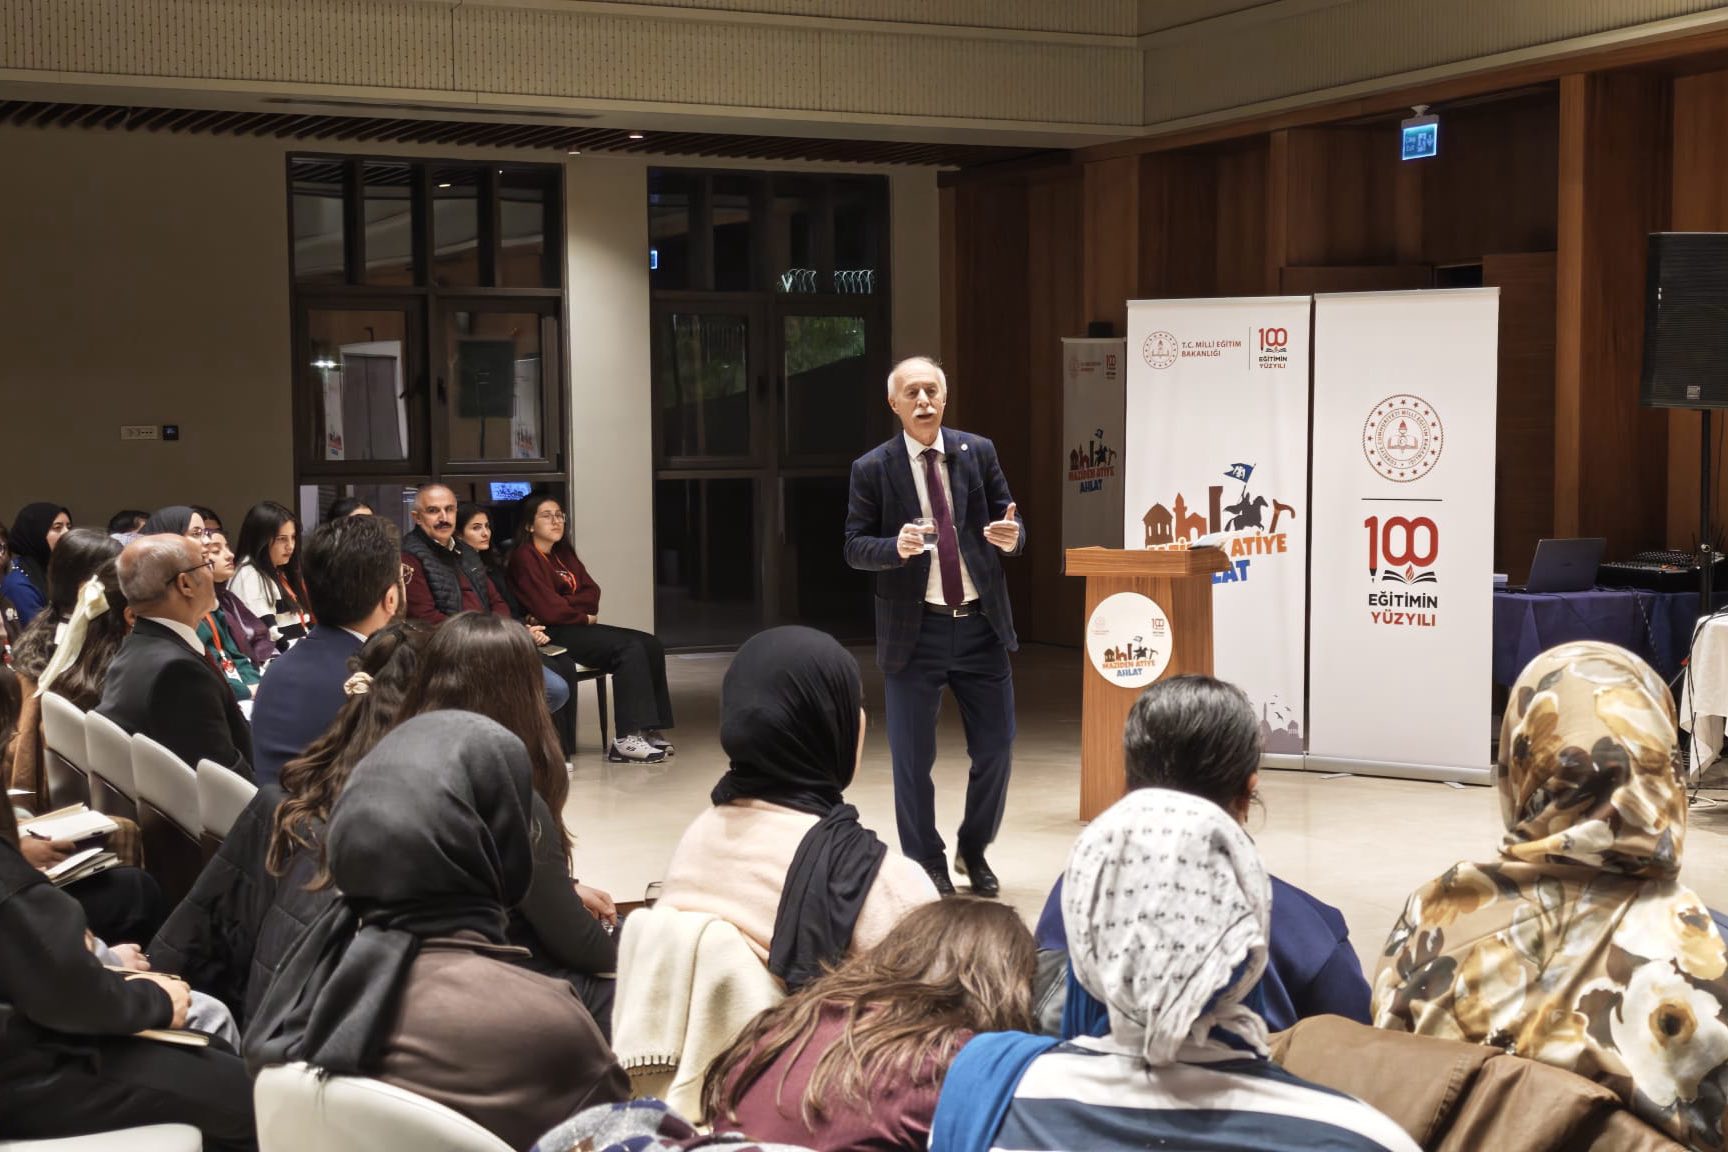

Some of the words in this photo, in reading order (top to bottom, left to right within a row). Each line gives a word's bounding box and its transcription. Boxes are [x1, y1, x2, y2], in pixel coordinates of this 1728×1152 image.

[1258, 328, 1288, 351] 100
[1181, 349, 1221, 357] BAKANLIĞI
[1231, 531, 1287, 557] ATİYE
[1364, 515, 1439, 580] 100
[1368, 590, 1438, 609] EĞİTİMİN
[1371, 609, 1436, 627] YÜZYILI
[1116, 668, 1143, 677] AHLAT
